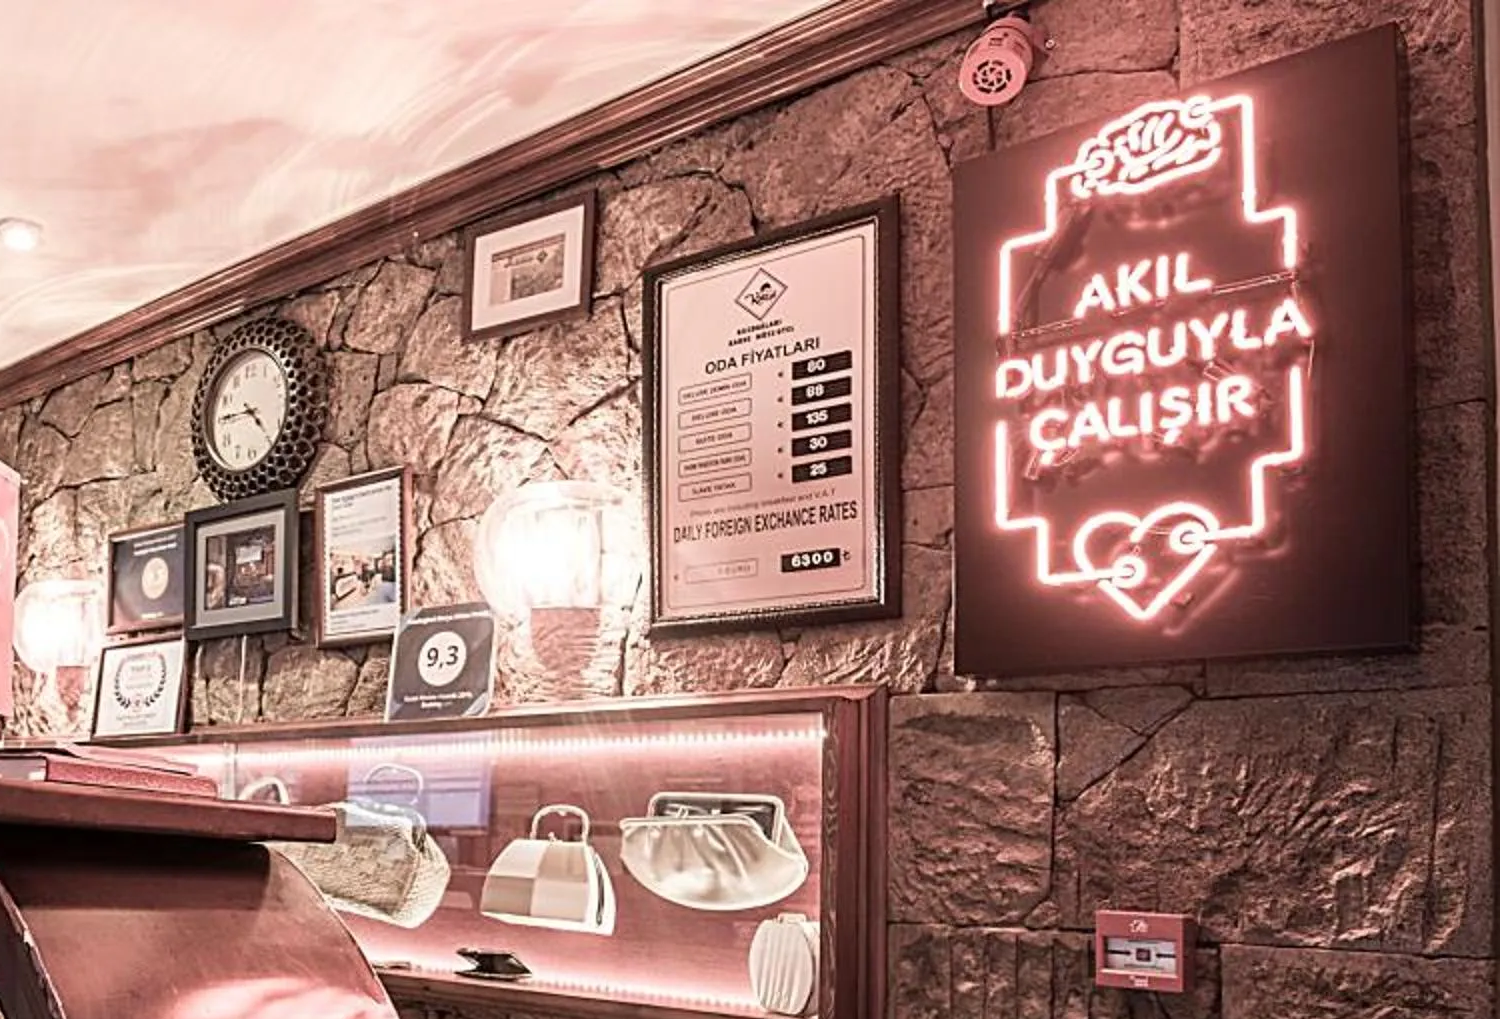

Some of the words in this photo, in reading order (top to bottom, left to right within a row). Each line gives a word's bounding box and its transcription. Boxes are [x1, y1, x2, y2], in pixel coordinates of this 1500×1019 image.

[1073, 252, 1214, 320] AKIL
[705, 356, 738, 375] ODA
[741, 336, 820, 367] FİYATLARI
[994, 298, 1314, 399] DUYGUYLA
[805, 410, 828, 425] 135
[1028, 375, 1255, 466] ÇALIŞIR
[809, 436, 828, 450] 30
[673, 526, 703, 544] DAILY
[705, 515, 752, 538] FOREIGN
[819, 500, 858, 522] RATES
[426, 645, 459, 669] 9,3
